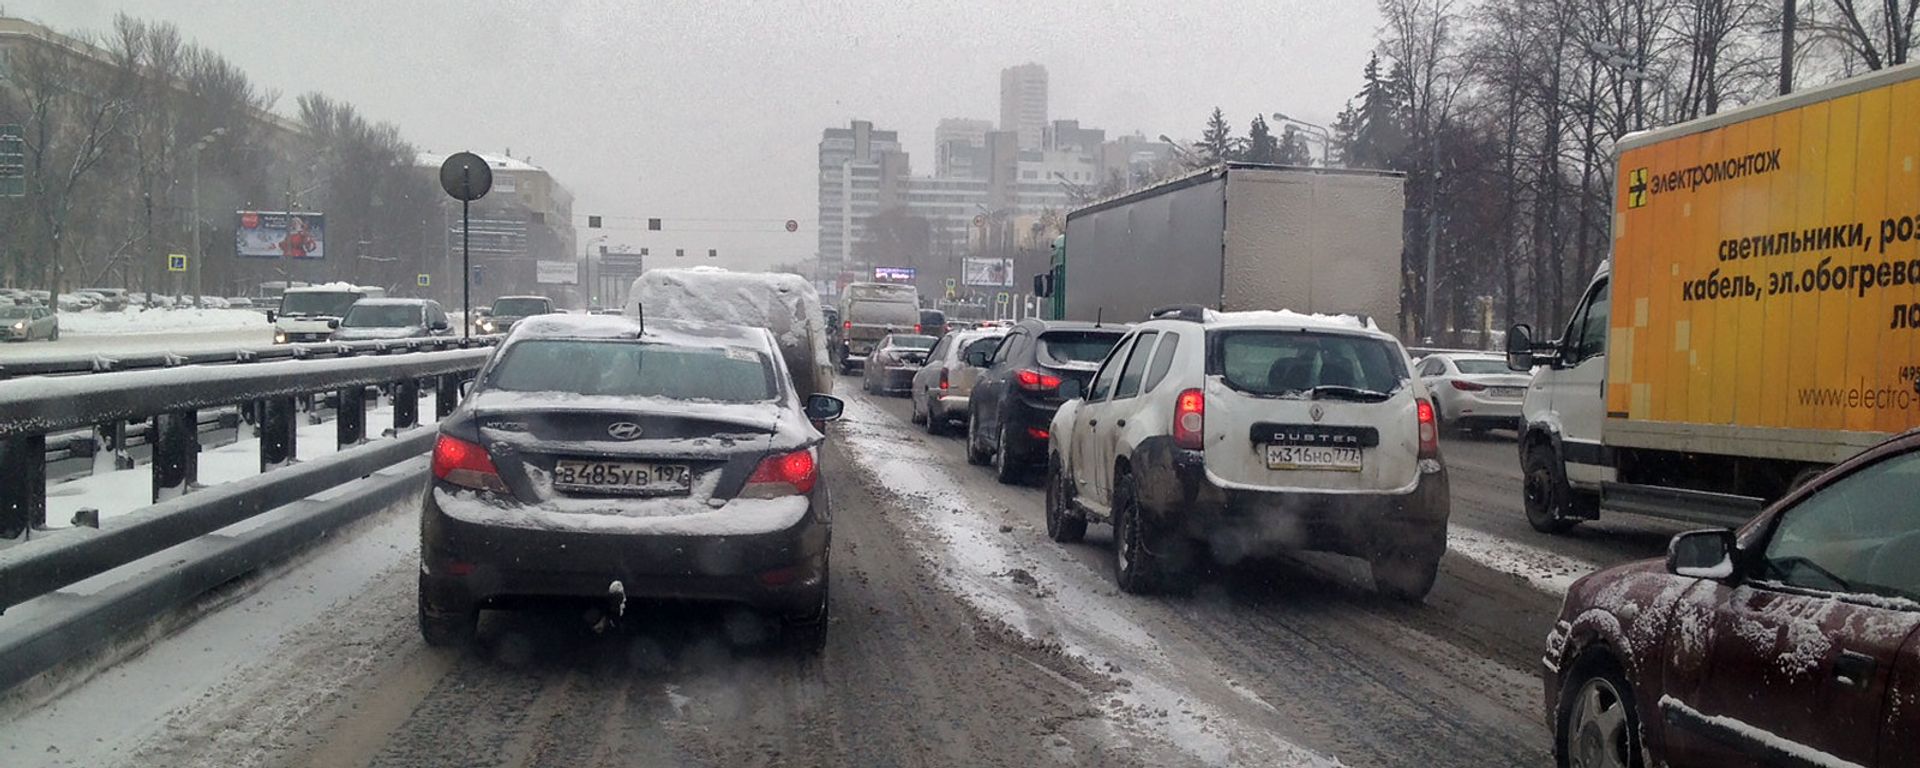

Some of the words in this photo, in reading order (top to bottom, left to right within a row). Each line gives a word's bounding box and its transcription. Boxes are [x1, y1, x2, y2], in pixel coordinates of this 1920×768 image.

[1650, 148, 1781, 195] электромонтаж
[1718, 222, 1871, 262] светильники,
[1683, 268, 1762, 301] кабель,
[1798, 376, 1920, 410] www.electro-
[1274, 432, 1357, 443] DUSTER
